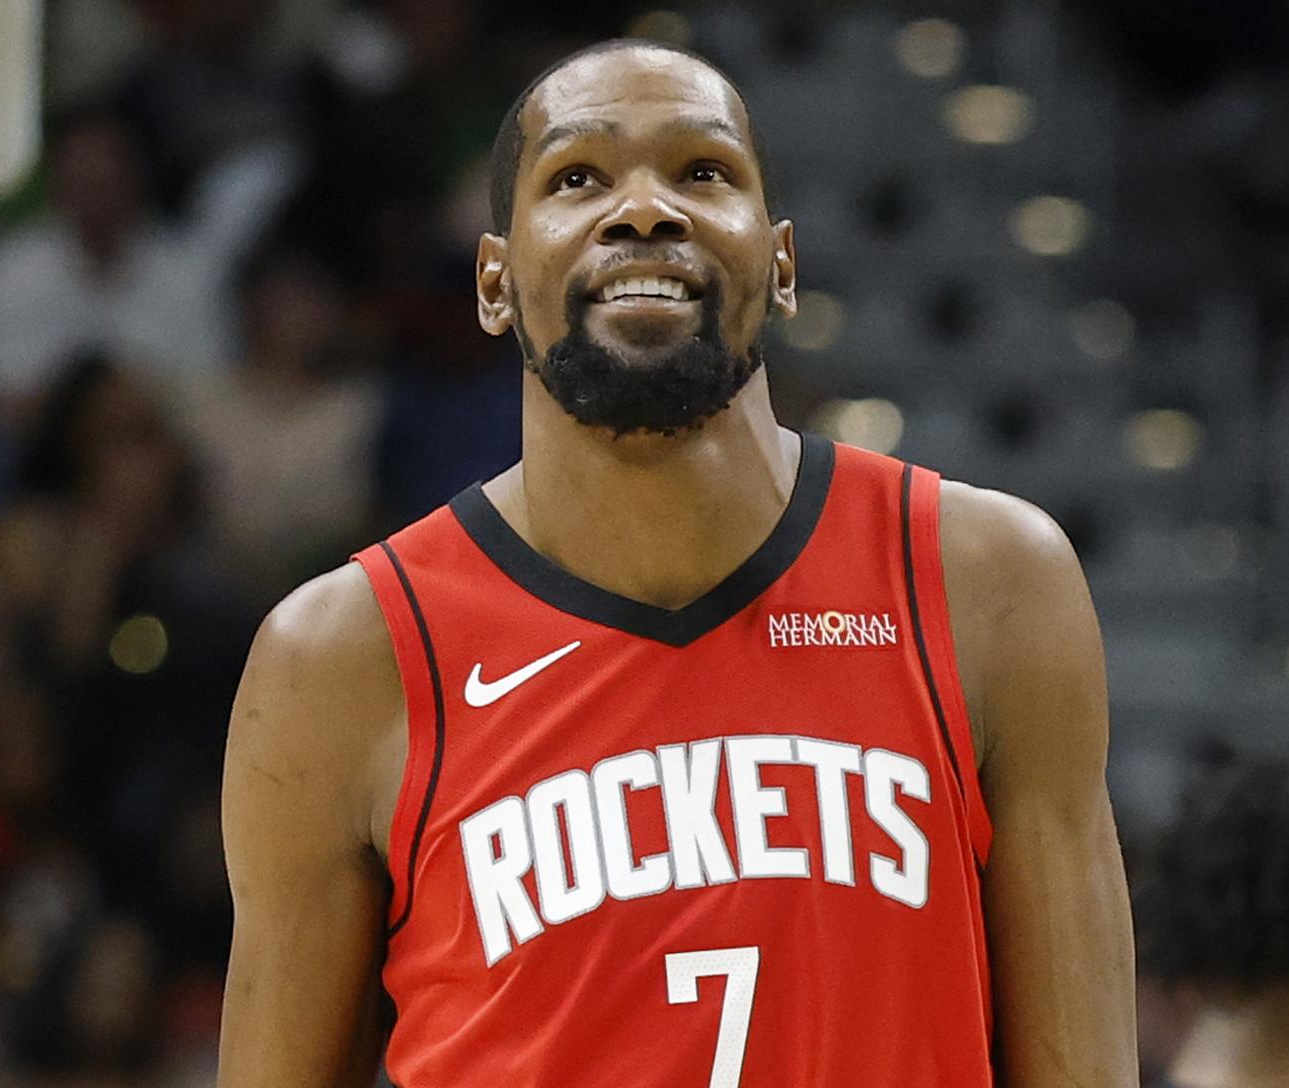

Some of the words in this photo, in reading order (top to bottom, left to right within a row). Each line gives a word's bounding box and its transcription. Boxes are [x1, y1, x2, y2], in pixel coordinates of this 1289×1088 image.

[769, 611, 898, 632] MEMORIAL
[770, 628, 898, 647] HERMANN
[459, 734, 932, 968] ROCKETS
